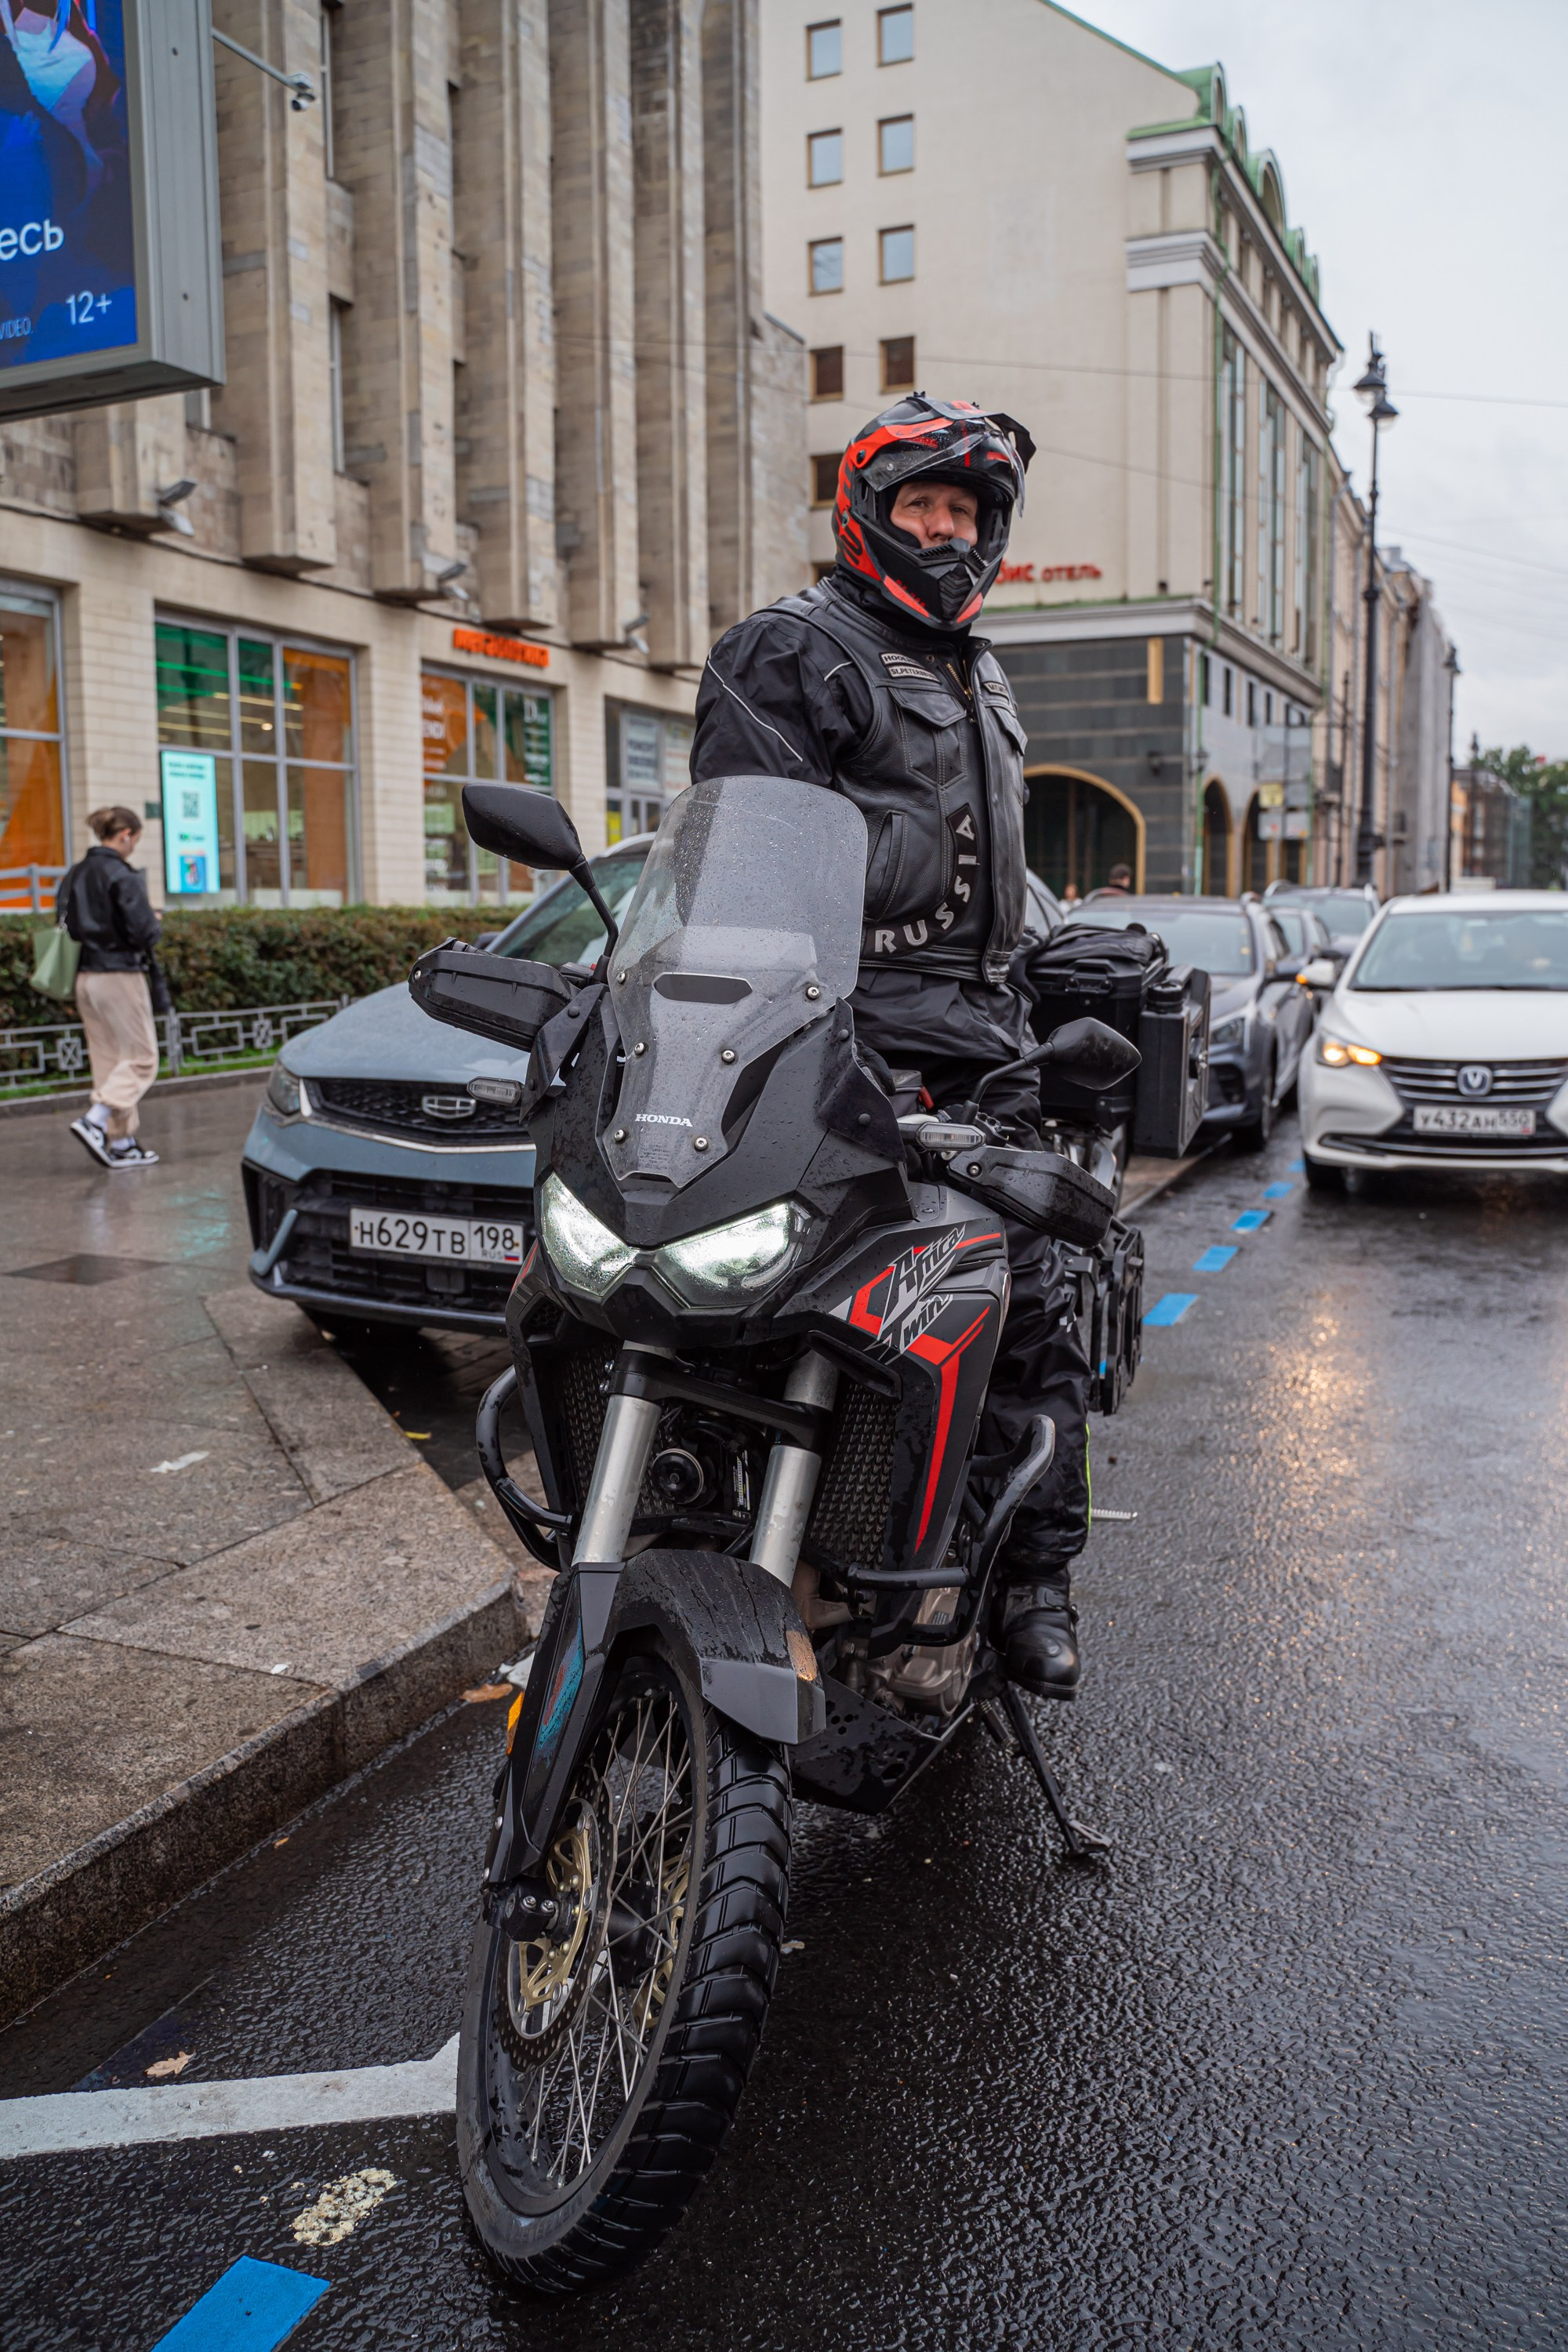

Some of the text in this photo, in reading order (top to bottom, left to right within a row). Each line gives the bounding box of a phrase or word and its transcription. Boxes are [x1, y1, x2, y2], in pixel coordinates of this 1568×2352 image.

[65, 290, 113, 325] 12+
[875, 815, 977, 953] RUSSIA
[635, 1113, 693, 1127] HONDA
[474, 1225, 516, 1250] 198
[881, 1223, 966, 1330] Africa
